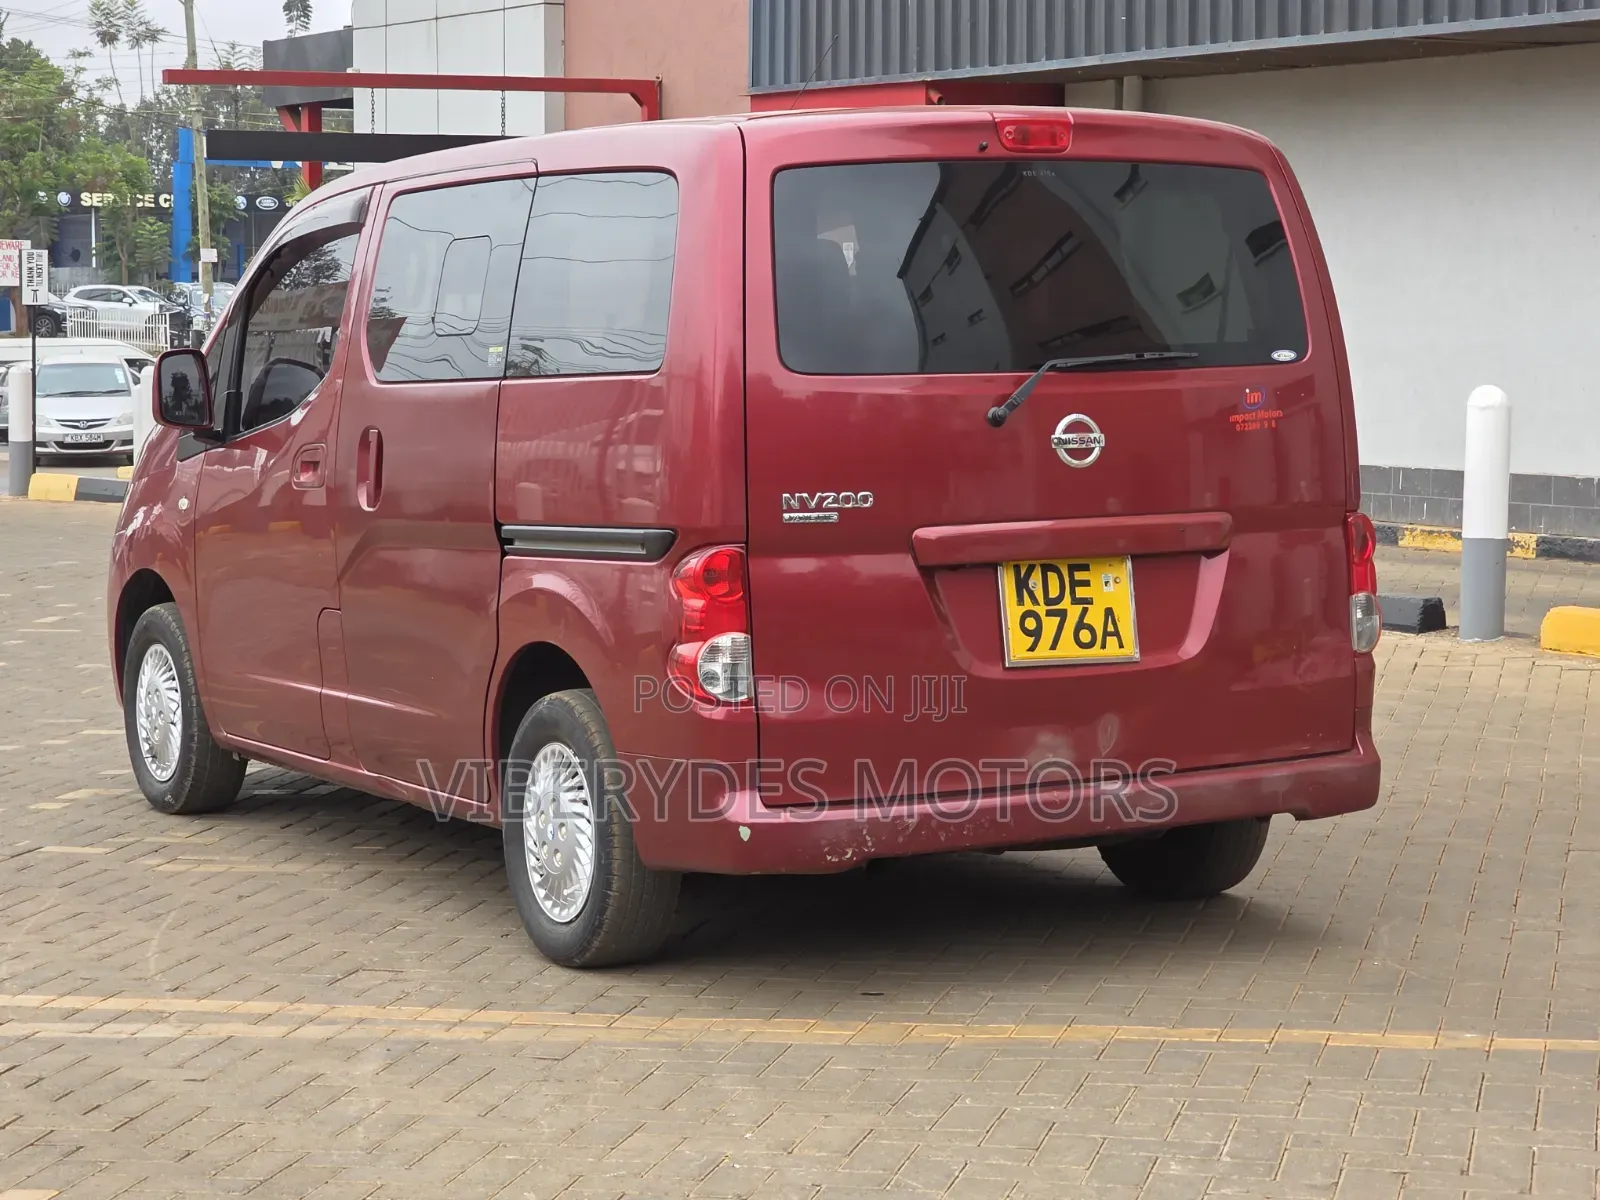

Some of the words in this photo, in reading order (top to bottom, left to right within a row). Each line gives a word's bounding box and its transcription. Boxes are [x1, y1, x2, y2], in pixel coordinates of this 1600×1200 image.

[27, 252, 35, 264] YOU
[27, 266, 35, 287] THANK
[1058, 435, 1101, 446] NISSAN
[782, 491, 874, 510] NV200
[1012, 563, 1094, 607] KDE
[1018, 606, 1125, 653] 976A
